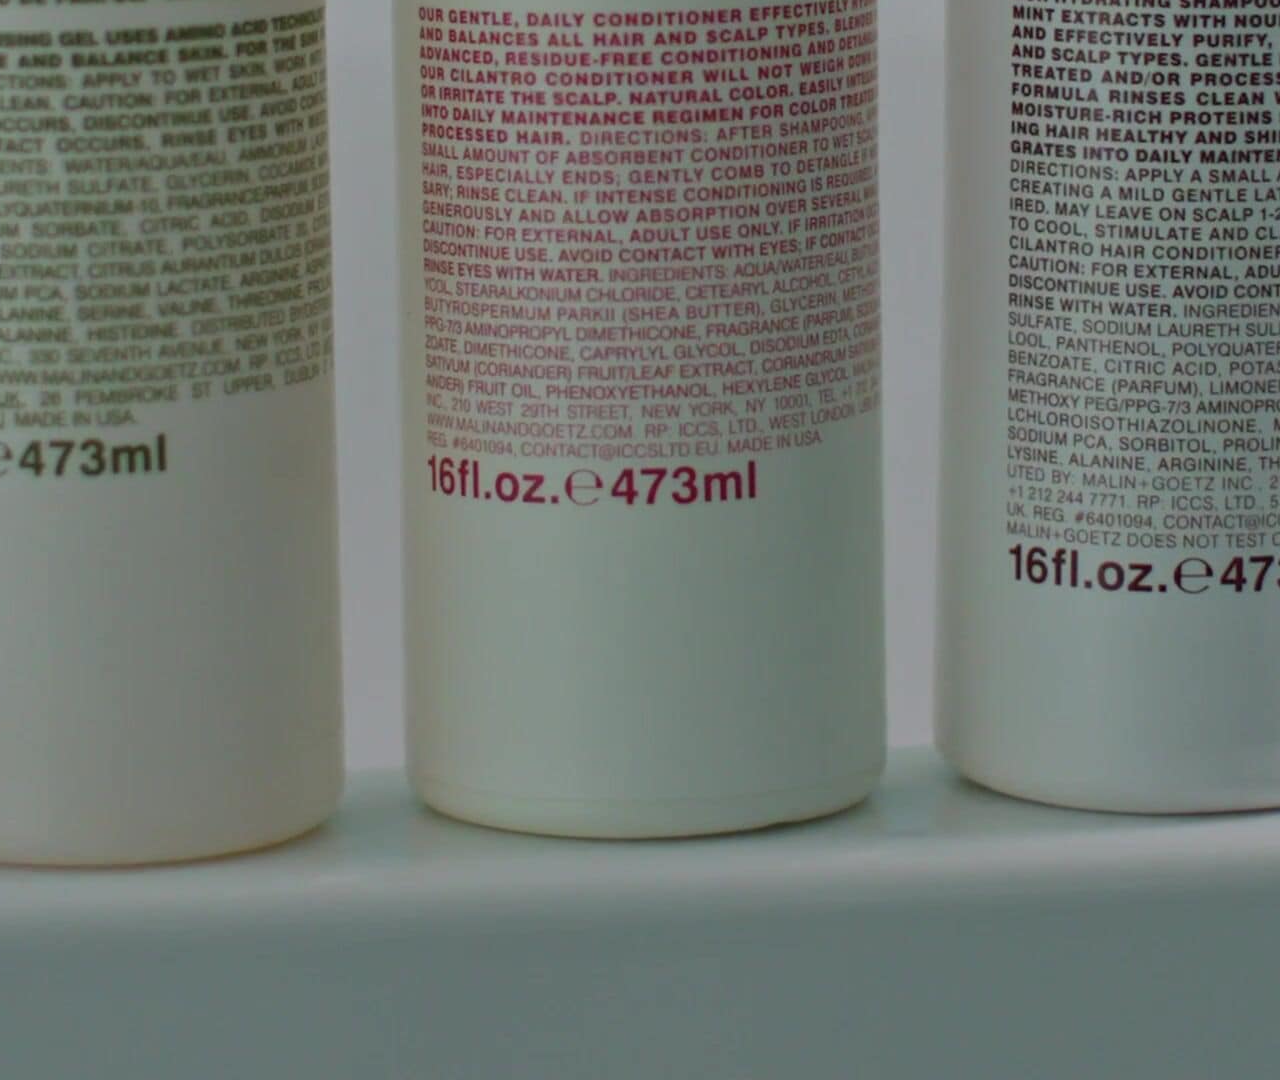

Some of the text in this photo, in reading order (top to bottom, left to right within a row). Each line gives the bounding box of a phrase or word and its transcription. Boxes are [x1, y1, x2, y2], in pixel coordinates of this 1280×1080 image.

[418, 7, 444, 23] OUR
[448, 9, 519, 28] GENTLE,
[592, 8, 742, 27] CONDITIONER
[1012, 5, 1055, 22] MINT
[1061, 9, 1165, 27] EXTRACTS
[1172, 14, 1226, 28] WITH
[419, 26, 443, 41] AND
[448, 28, 539, 46] BALANCES
[547, 33, 583, 47] ALL
[592, 33, 644, 47] HAIR
[653, 31, 698, 46] AND
[705, 26, 768, 44] SCALP
[1011, 24, 1046, 41] AND
[1053, 28, 1184, 47] EFFECTIVELY
[1192, 34, 1272, 49] PURIFY,
[419, 45, 498, 66] ADVANCED,
[505, 51, 653, 66] RESIDUE-FREE
[660, 43, 802, 66] CONDITIONING
[805, 37, 835, 57] AND
[1011, 44, 1046, 60] AND
[1050, 47, 1111, 64] SCALP
[1194, 52, 1273, 67] GENTLE
[419, 65, 444, 81] OUR
[449, 67, 536, 86] CILANTRO
[544, 70, 693, 86] CONDITIONER
[702, 67, 753, 83] WILL
[757, 63, 796, 81] NOT
[798, 55, 844, 77] WEIGH
[1011, 63, 1092, 83] TREATED
[1100, 70, 1180, 86] AND/OR
[420, 84, 436, 99] OR
[438, 86, 504, 104] IRRITATE
[510, 91, 546, 105] THE
[552, 92, 622, 106] SCALP.
[628, 88, 723, 106] NATURAL
[728, 81, 795, 103] COLOR.
[797, 76, 843, 97] EASILY
[1011, 82, 1099, 102] FORMULA
[1108, 90, 1186, 106] RINSES
[1195, 92, 1265, 105] CLEAN
[421, 103, 449, 120] INTO
[501, 110, 645, 125] MAINTENANCE
[651, 106, 744, 125] REGIMEN
[749, 102, 787, 121] FOR
[788, 96, 836, 117] COLOR
[1011, 101, 1162, 124] MOISTURE-RICH
[1169, 111, 1272, 125] PROTEINS
[421, 122, 508, 144] PROCESSED
[516, 131, 570, 145] HAIR.
[716, 124, 772, 142] AFTER
[1010, 120, 1039, 137] ING
[1045, 124, 1089, 140] HAIR
[1095, 128, 1188, 144] HEALTHY
[1194, 131, 1237, 144] AND
[421, 137, 829, 165] SMALL AMOUNT OF ABSORBENT CONDITIONER TO
[1010, 139, 1076, 159] GRATES
[1082, 146, 1129, 162] INTO
[1124, 168, 1184, 183] APPLY
[1190, 170, 1202, 183] A
[1208, 169, 1272, 183] SMALL
[1127, 533, 1177, 548] DOES
[1182, 535, 1218, 548] NOT
[1225, 533, 1266, 548] TEST
